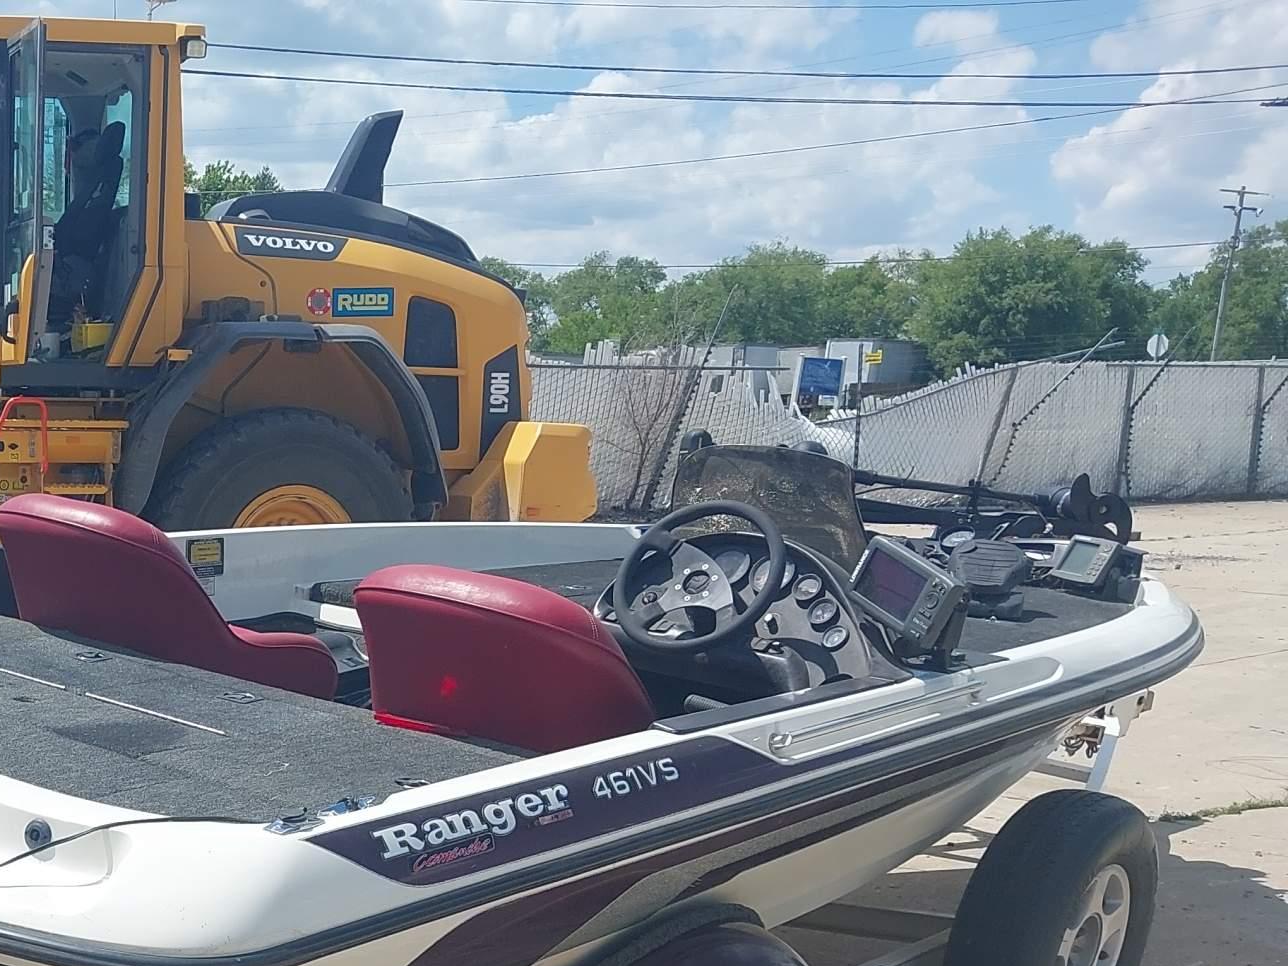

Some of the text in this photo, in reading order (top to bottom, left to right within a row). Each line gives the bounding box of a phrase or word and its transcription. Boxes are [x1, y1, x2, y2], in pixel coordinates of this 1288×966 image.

[243, 234, 334, 253] VOLVO
[337, 294, 389, 311] RUDD
[489, 372, 510, 413] L90H
[372, 757, 680, 860] Ranger 461VS
